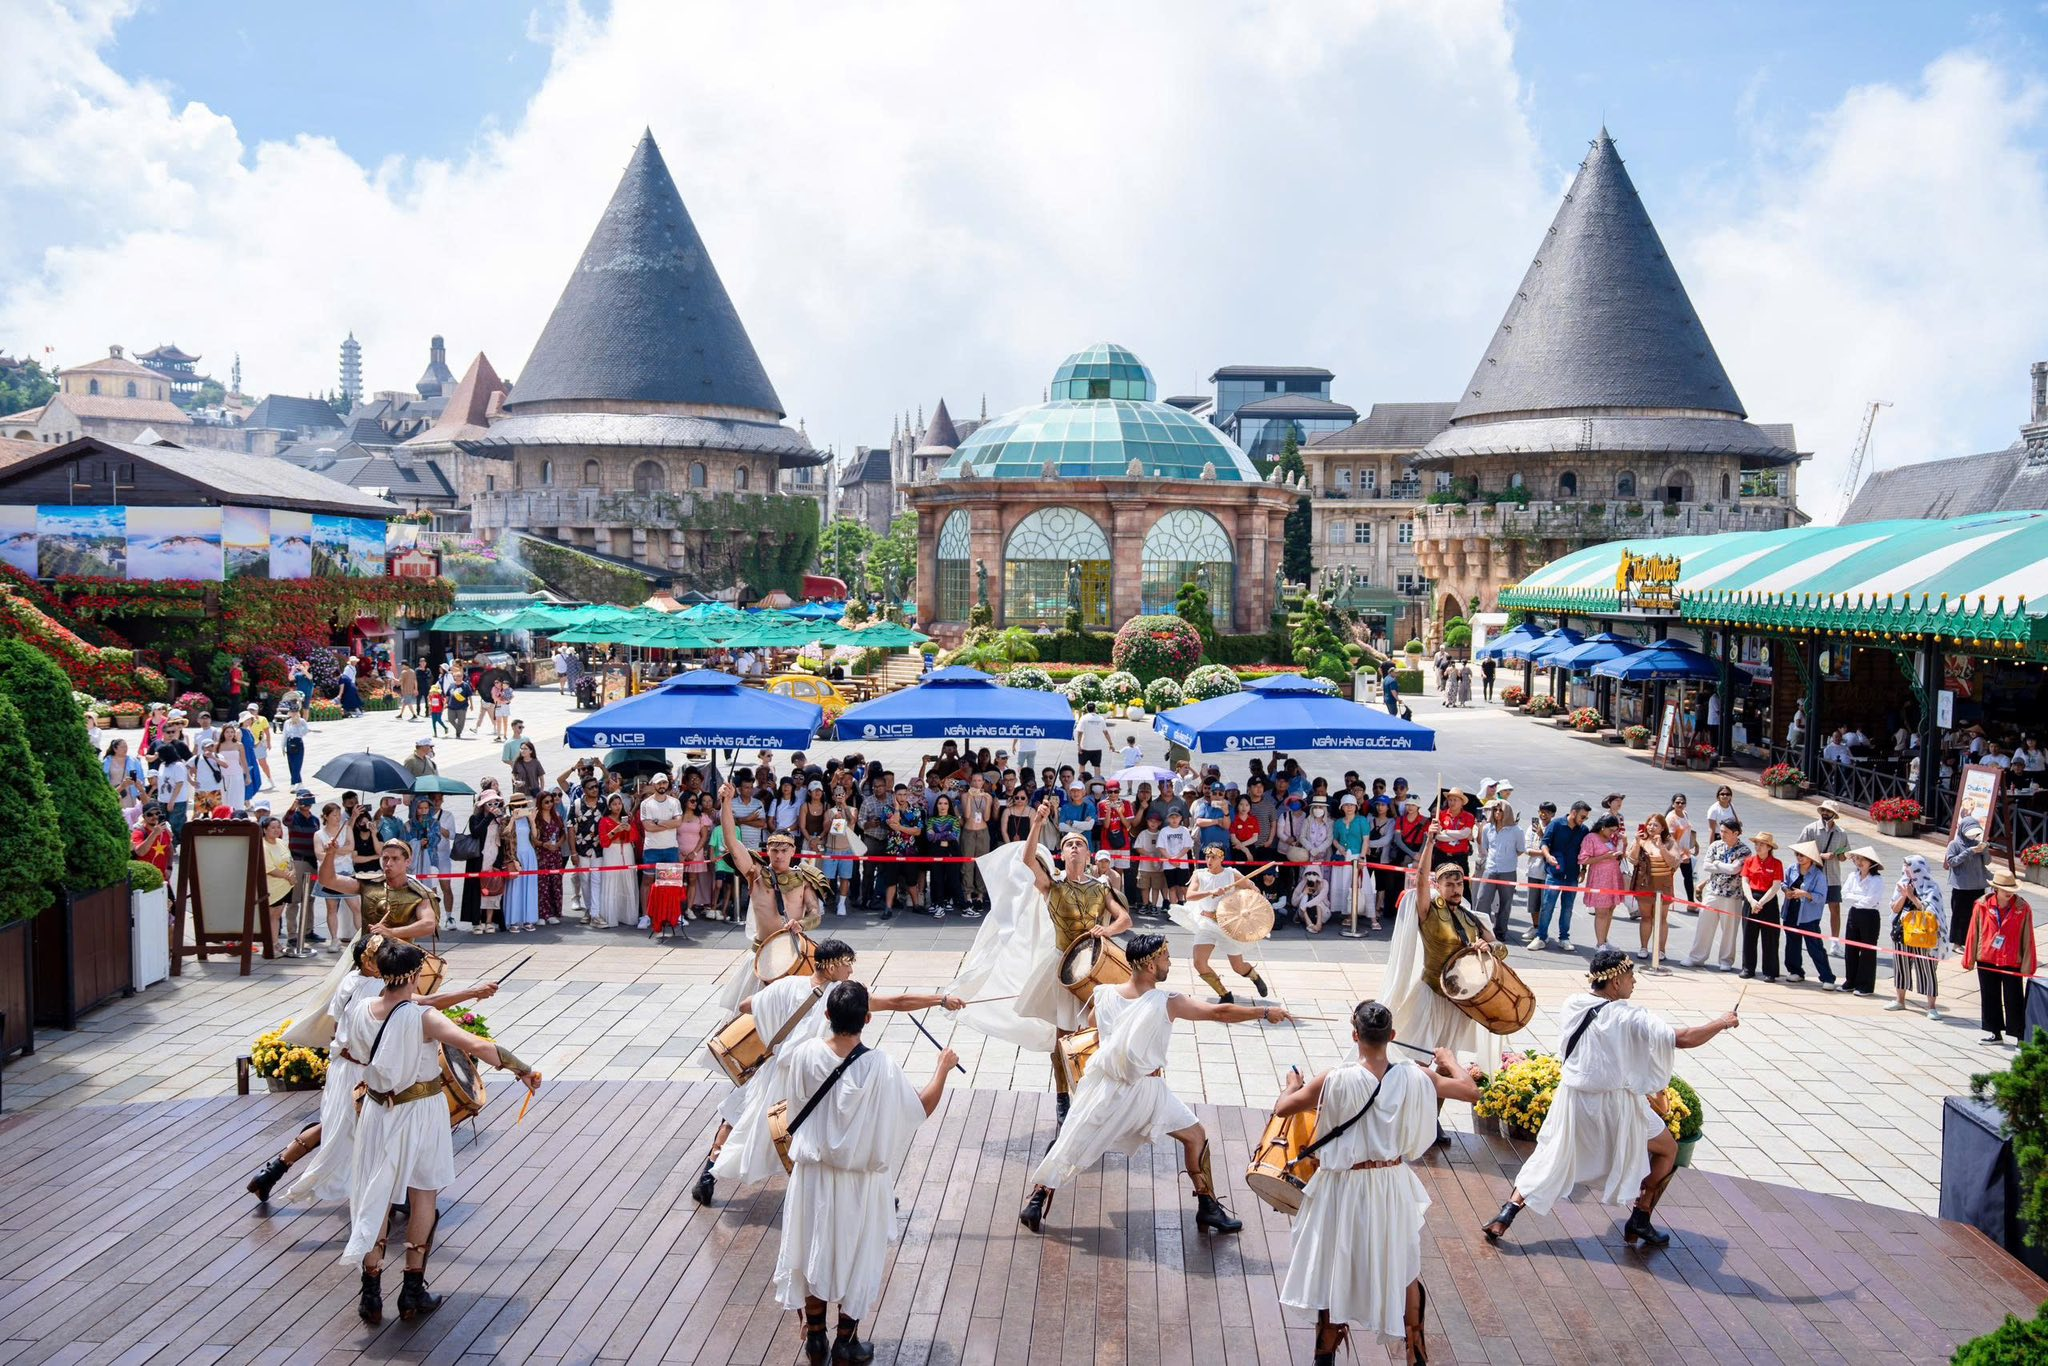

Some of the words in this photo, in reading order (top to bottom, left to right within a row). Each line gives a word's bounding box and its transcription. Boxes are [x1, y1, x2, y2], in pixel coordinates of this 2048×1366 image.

[880, 724, 913, 734] NCB
[944, 724, 970, 736] NGÂN
[971, 724, 997, 736] HÀNG
[998, 724, 1024, 736] QUỐC
[1025, 725, 1045, 737] DÂN
[610, 733, 645, 743] NCB
[680, 733, 707, 745] NGÂN
[707, 734, 734, 746] HÀNG
[735, 735, 761, 747] QUỐC
[762, 736, 782, 747] DÂN
[1242, 736, 1276, 746] NCB
[1312, 735, 1338, 747] NGÂN
[1338, 735, 1365, 747] HÀNG
[1365, 736, 1391, 747] QUỐC
[1391, 736, 1412, 748] DÂN
